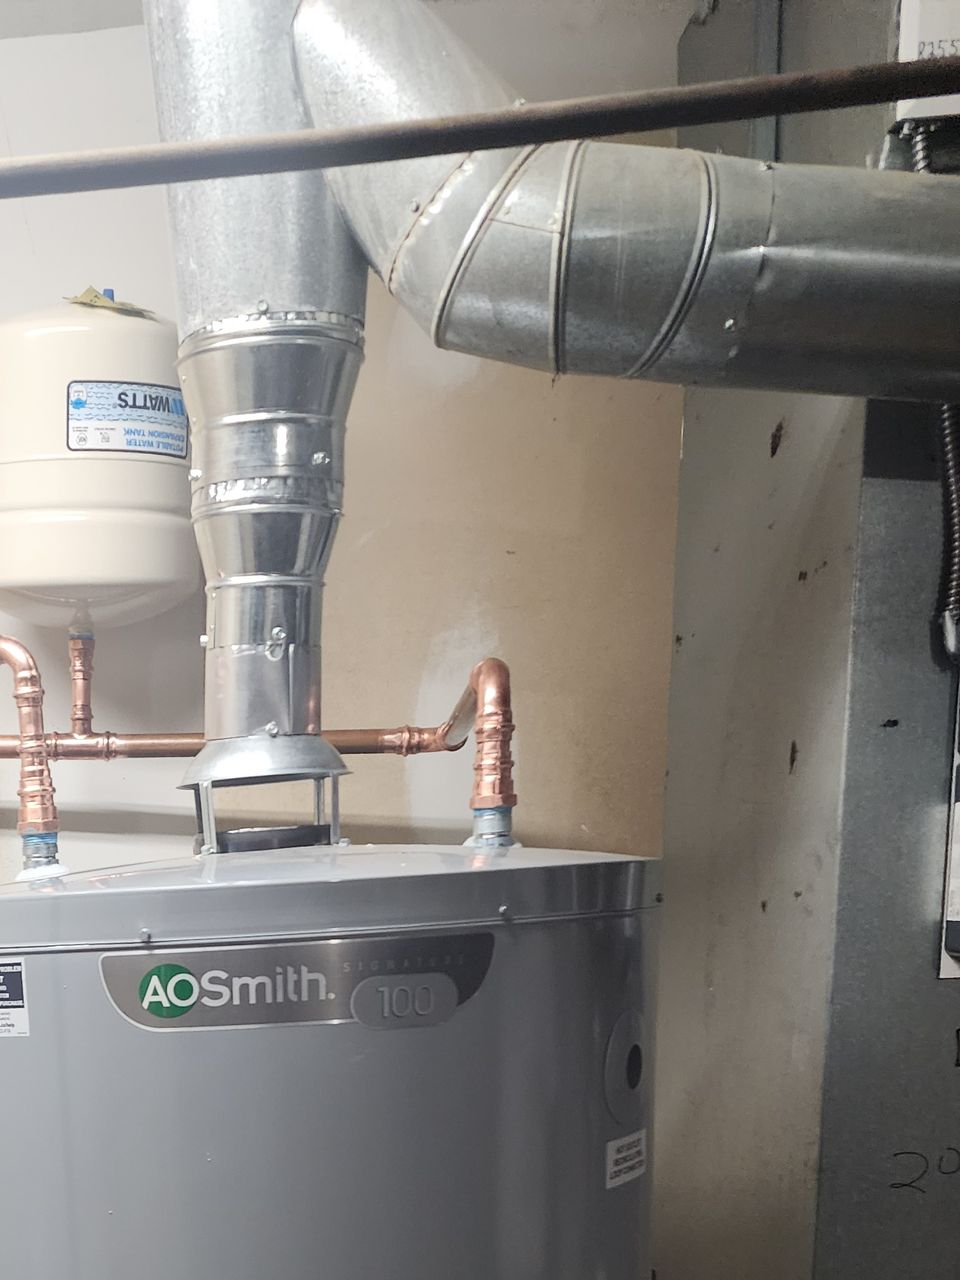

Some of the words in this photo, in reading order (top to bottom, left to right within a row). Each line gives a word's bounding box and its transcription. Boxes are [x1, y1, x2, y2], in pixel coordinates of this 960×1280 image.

[117, 392, 170, 413] WATTS
[123, 428, 145, 436] TANK
[125, 439, 153, 448] WATER
[377, 985, 434, 1018] 100
